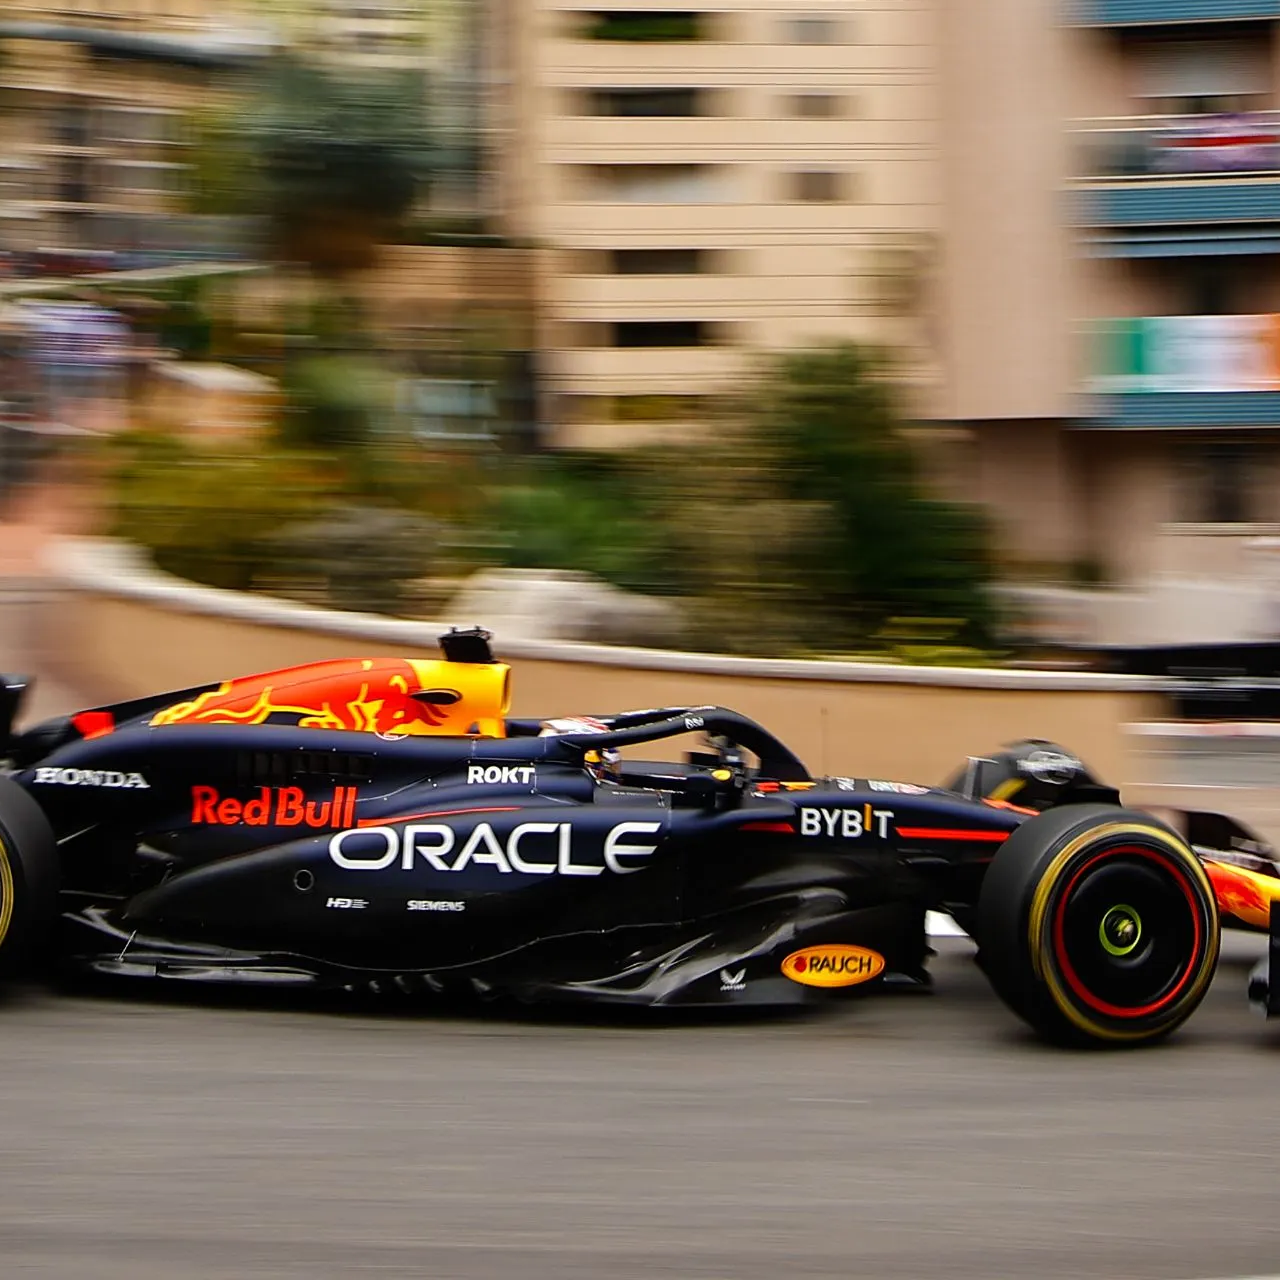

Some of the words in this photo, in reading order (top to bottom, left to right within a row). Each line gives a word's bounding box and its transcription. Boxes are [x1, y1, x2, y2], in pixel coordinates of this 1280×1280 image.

[33, 767, 151, 788] HONDA
[467, 766, 536, 785] ROKT
[191, 785, 271, 826] Red
[275, 786, 357, 829] Bull
[801, 803, 894, 839] BYBIT
[328, 822, 662, 875] ORACLE
[406, 899, 466, 912] SIEMENS
[808, 956, 873, 975] RAUCH
